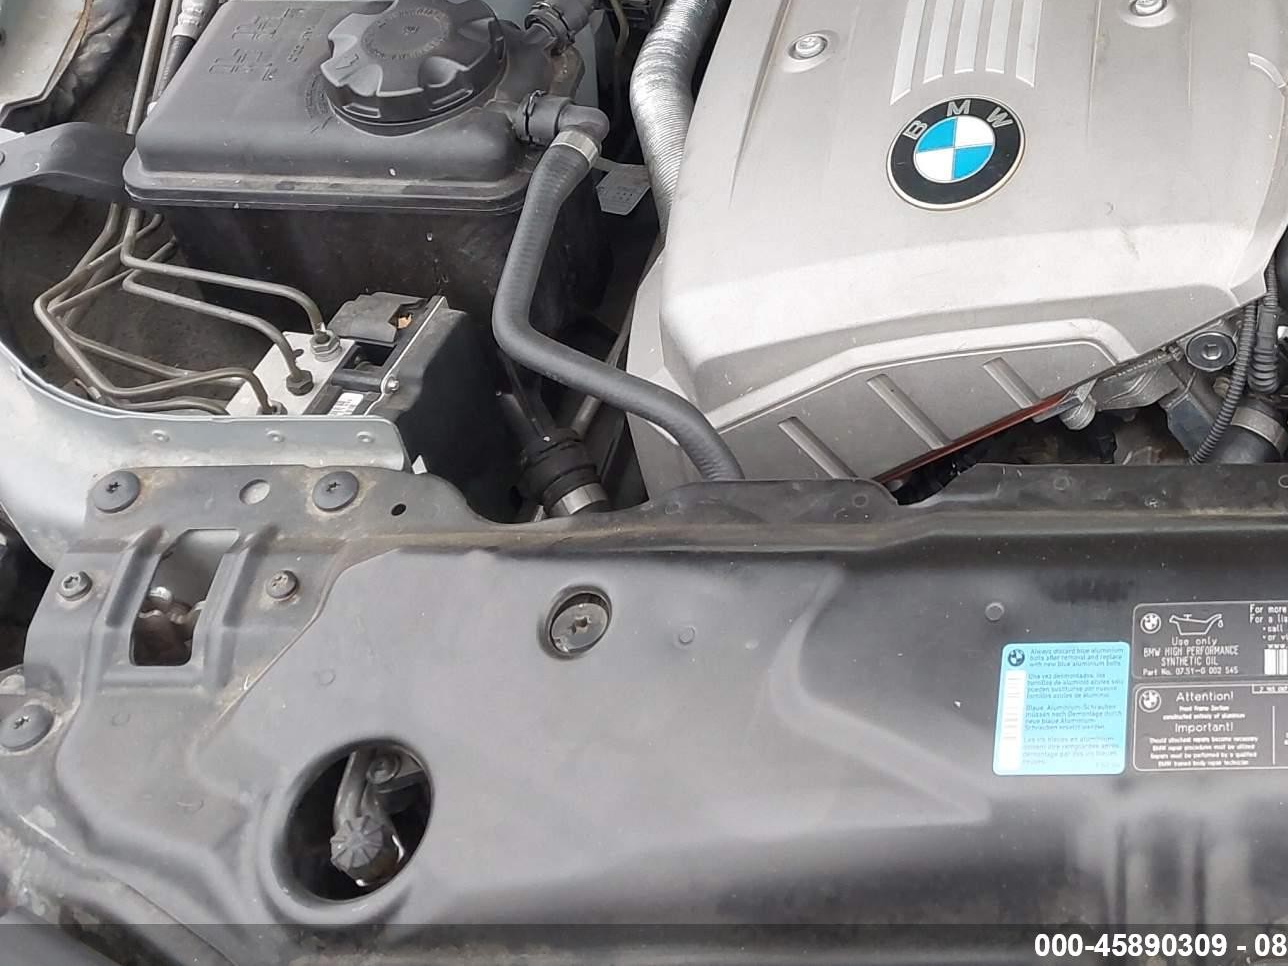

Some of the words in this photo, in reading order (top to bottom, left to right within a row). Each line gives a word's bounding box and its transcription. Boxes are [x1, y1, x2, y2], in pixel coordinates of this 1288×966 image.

[903, 99, 1013, 140] BMW
[1250, 604, 1263, 613] For
[1268, 605, 1287, 613] more
[1250, 614, 1263, 623] For
[1268, 615, 1272, 623] a
[1172, 637, 1189, 645] Use
[1196, 637, 1217, 646] only
[1144, 647, 1161, 657] BMW
[1164, 647, 1182, 656] HIGH
[1186, 645, 1239, 656] PERFORMANCE
[1161, 656, 1202, 666] SYNTHETIC
[1206, 656, 1218, 666] OIL
[1176, 691, 1234, 702] Attention!
[1175, 722, 1234, 733] Important!
